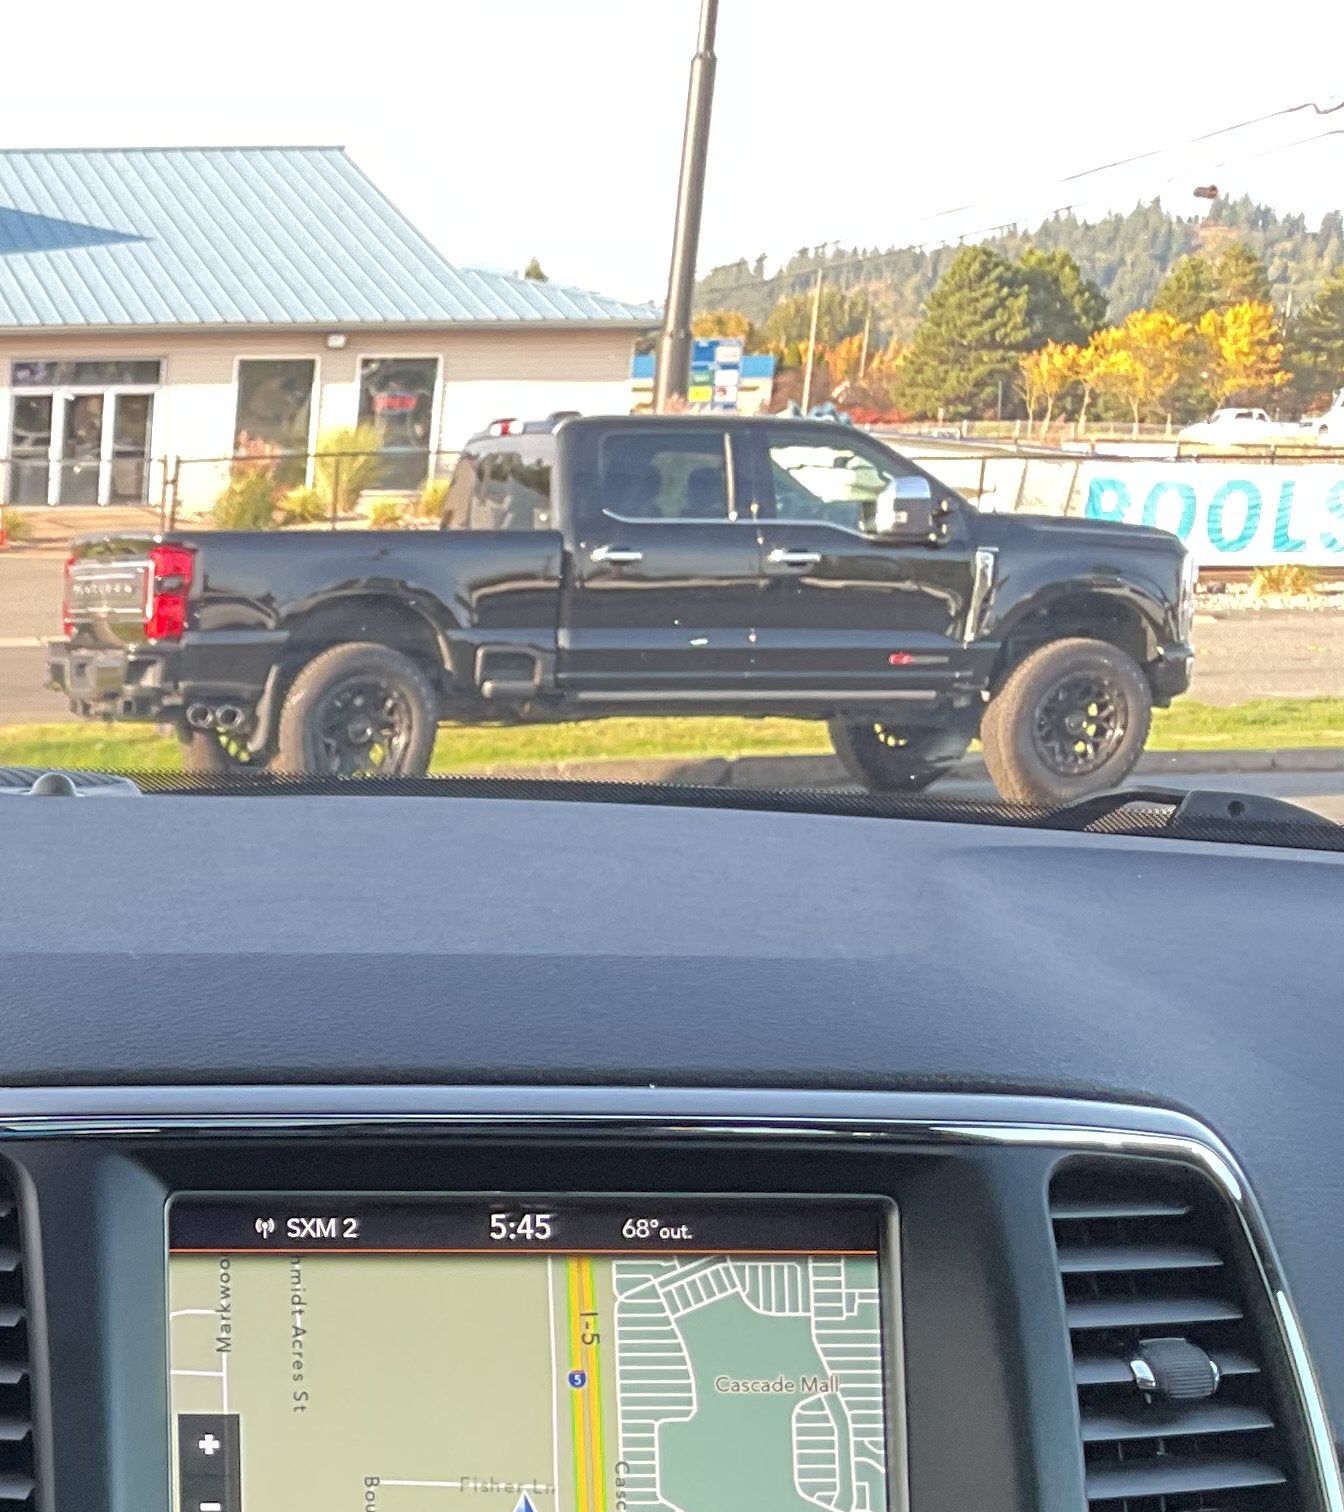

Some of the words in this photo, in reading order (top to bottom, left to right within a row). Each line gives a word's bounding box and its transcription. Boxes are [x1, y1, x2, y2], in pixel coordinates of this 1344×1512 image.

[286, 1217, 337, 1239] SXM
[342, 1217, 359, 1239] 2
[489, 1213, 552, 1241] 5:45
[291, 1324, 308, 1382] Acres
[715, 1376, 796, 1394] Cascade
[800, 1374, 839, 1393] Mall
[292, 1391, 309, 1413] St
